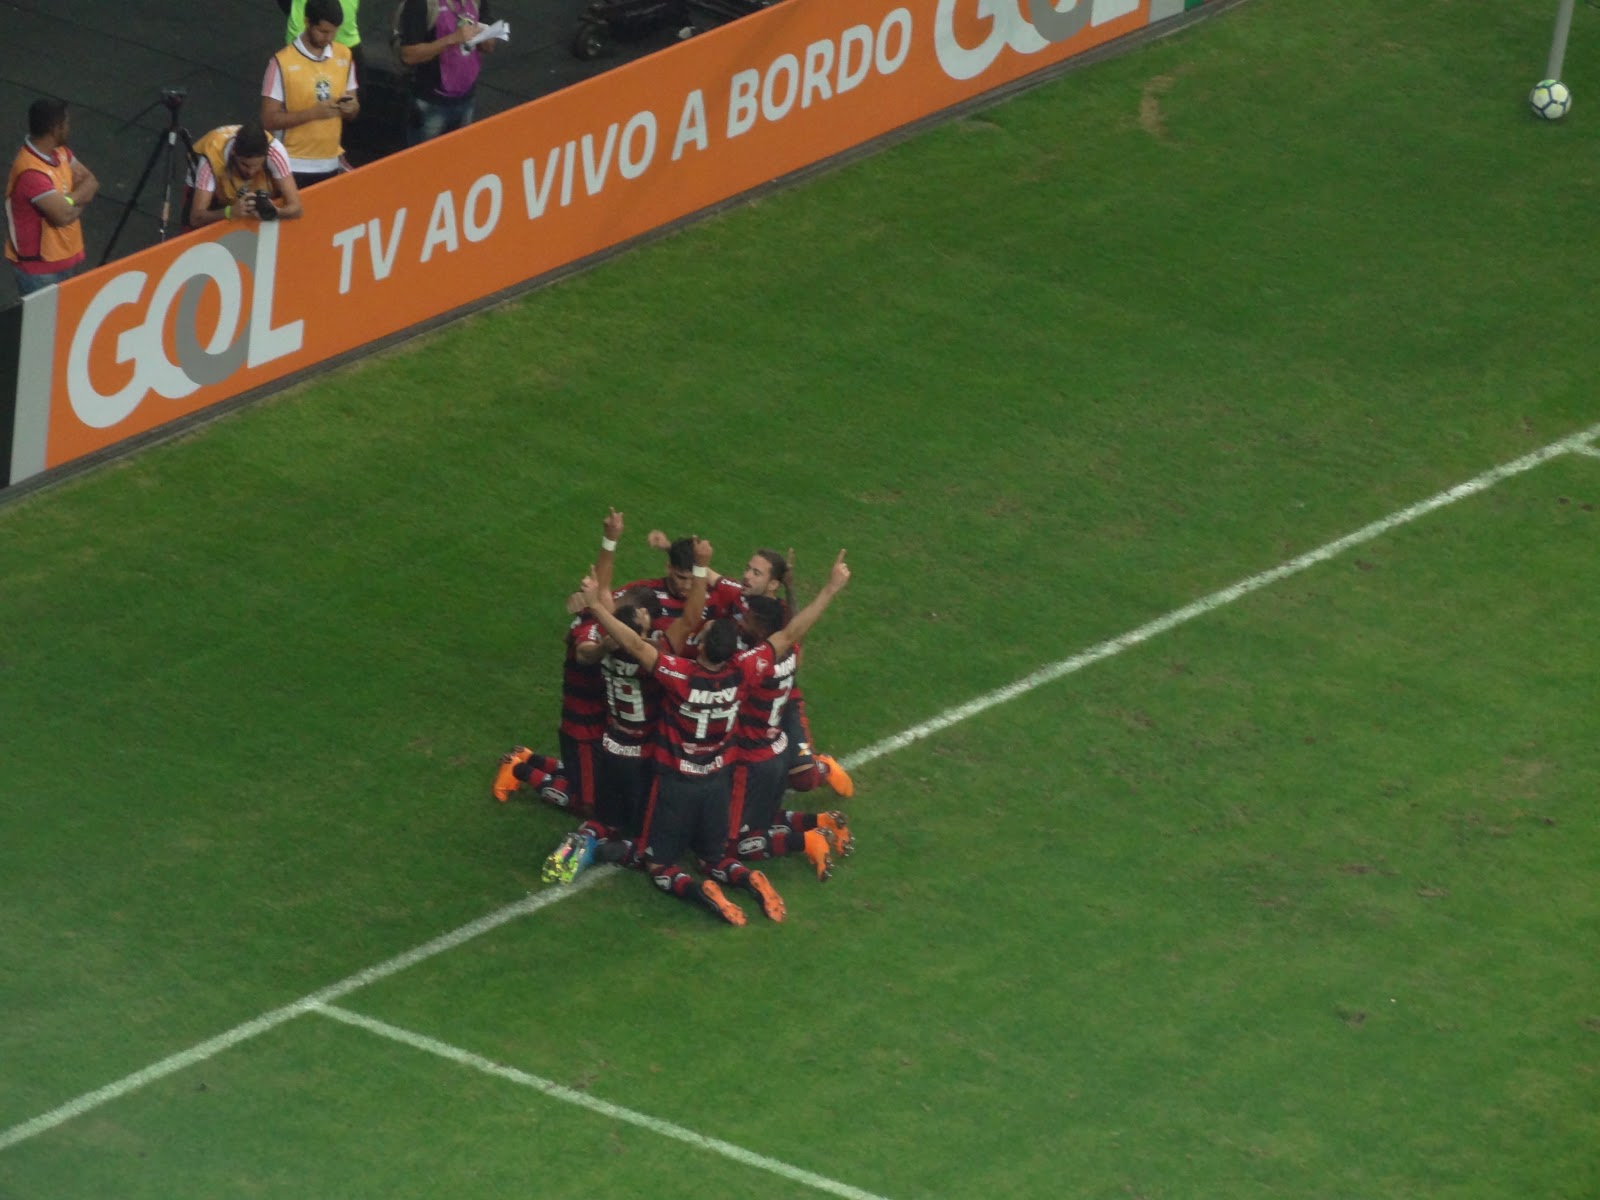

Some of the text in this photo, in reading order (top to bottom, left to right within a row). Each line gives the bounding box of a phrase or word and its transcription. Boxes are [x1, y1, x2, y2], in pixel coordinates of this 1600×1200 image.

[332, 207, 407, 295] TV
[419, 173, 503, 263] AO
[522, 110, 658, 220] VIVO
[671, 89, 709, 161] A
[726, 7, 913, 139] BORDO
[66, 219, 305, 429] GOL
